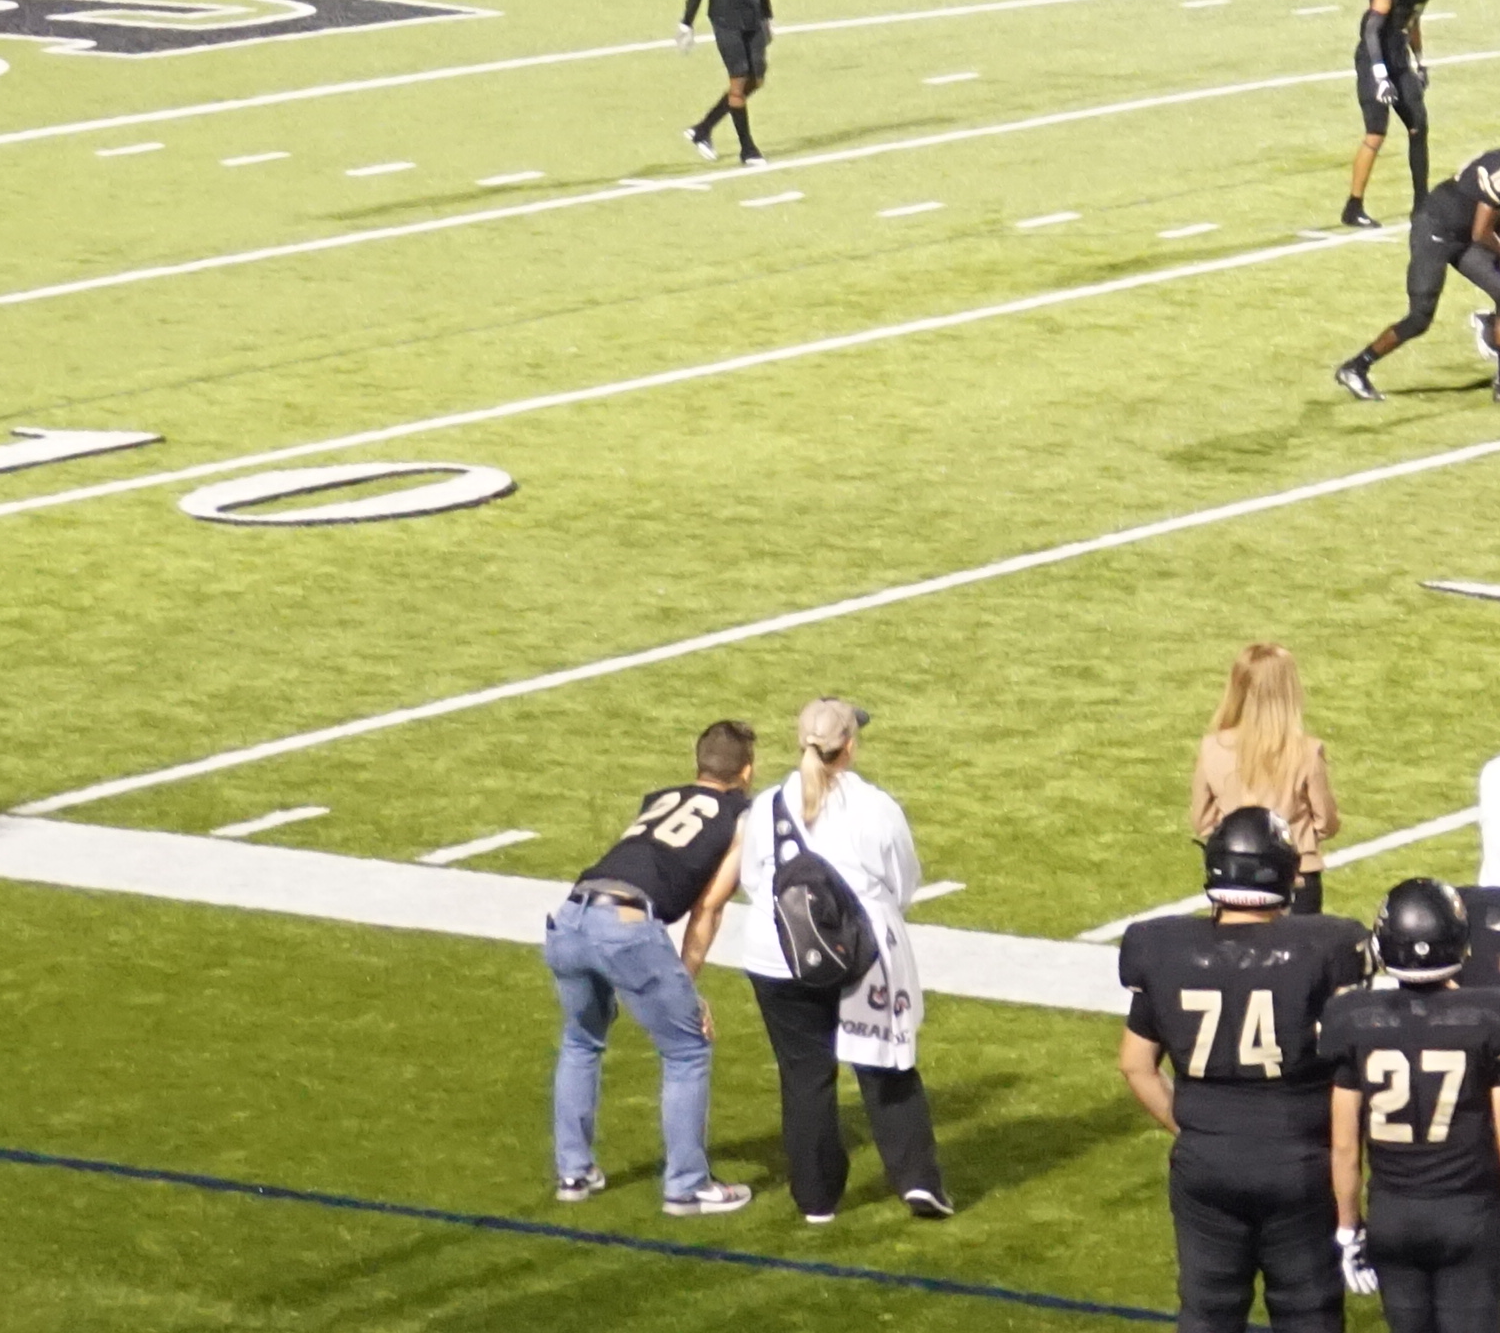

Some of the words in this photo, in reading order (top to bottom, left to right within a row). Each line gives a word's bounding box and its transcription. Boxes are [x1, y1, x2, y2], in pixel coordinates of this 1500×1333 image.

[621, 791, 720, 848] 26
[1180, 989, 1283, 1079] 74
[1366, 1049, 1466, 1143] 27
